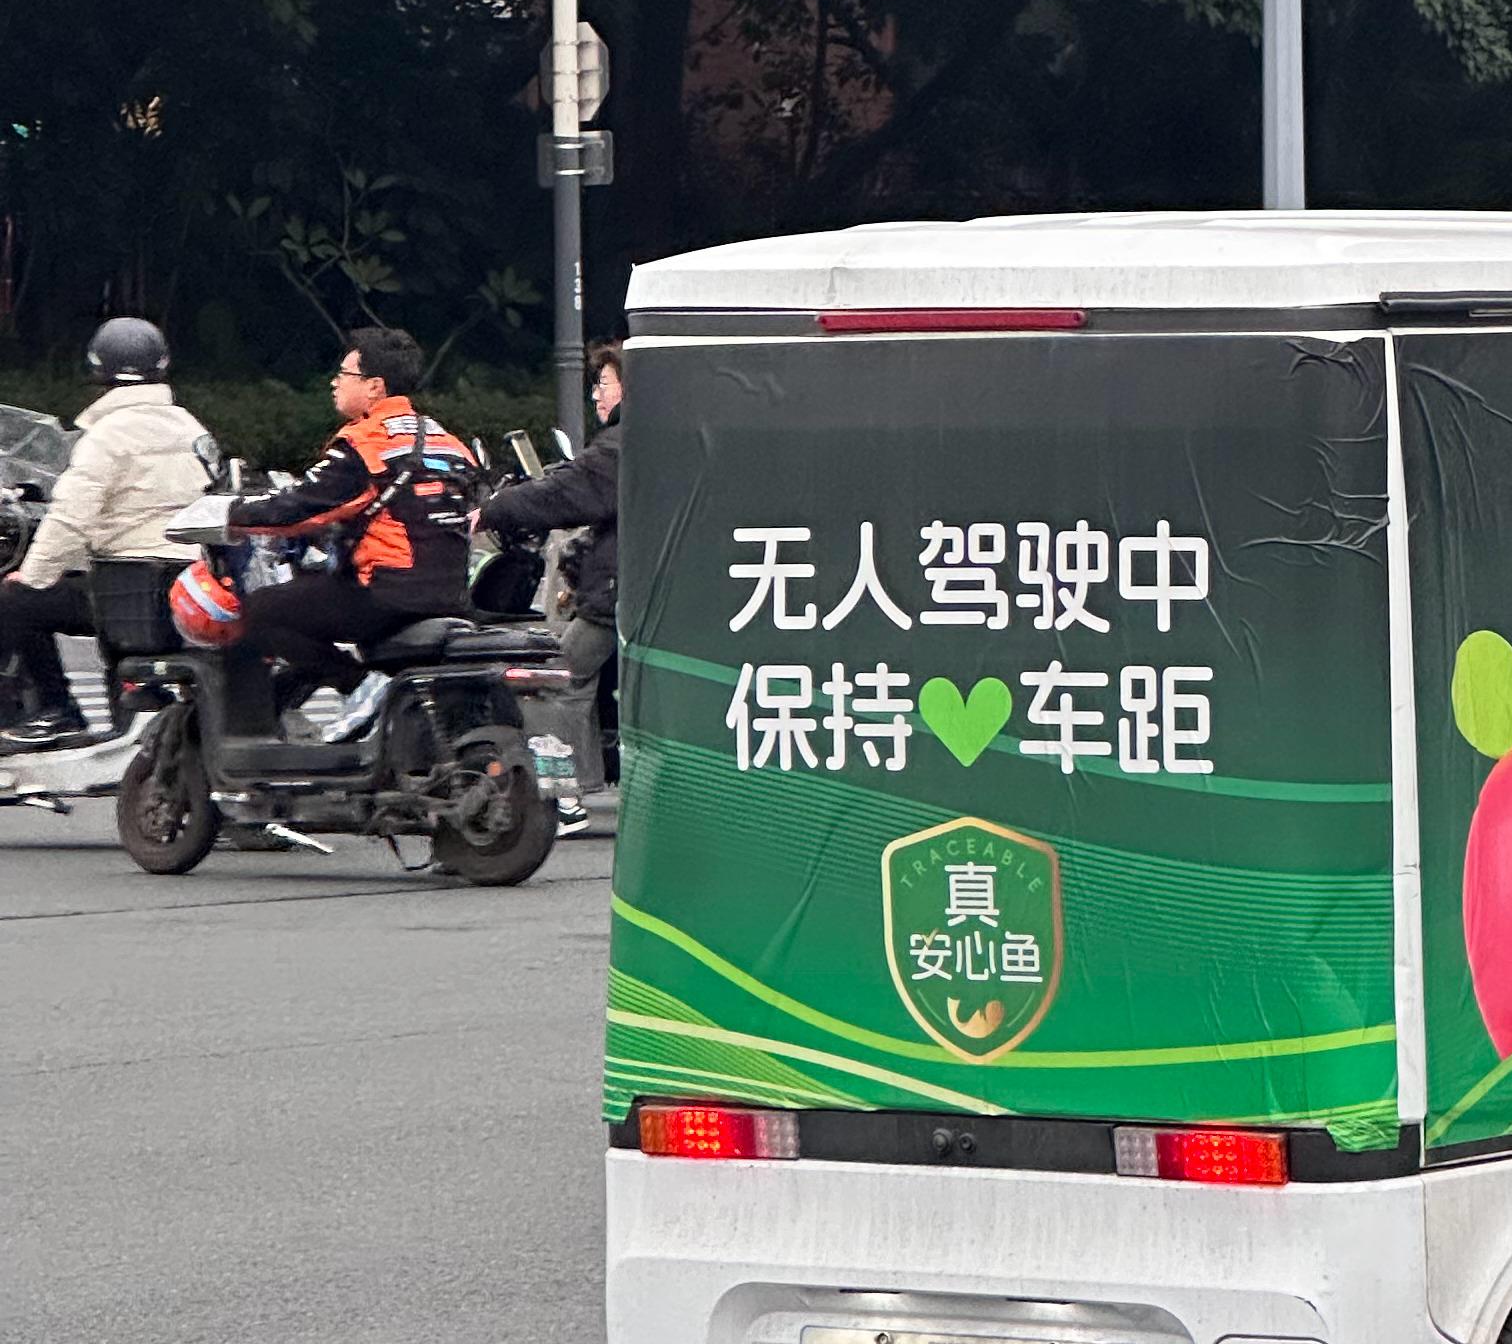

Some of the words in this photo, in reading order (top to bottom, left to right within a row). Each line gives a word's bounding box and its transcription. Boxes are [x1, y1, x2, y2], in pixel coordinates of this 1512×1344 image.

[728, 519, 1209, 633] 无人驾驶中
[900, 838, 1043, 893] TRACEABLE
[944, 861, 1000, 928] 真
[909, 929, 1043, 983] 安心鱼
